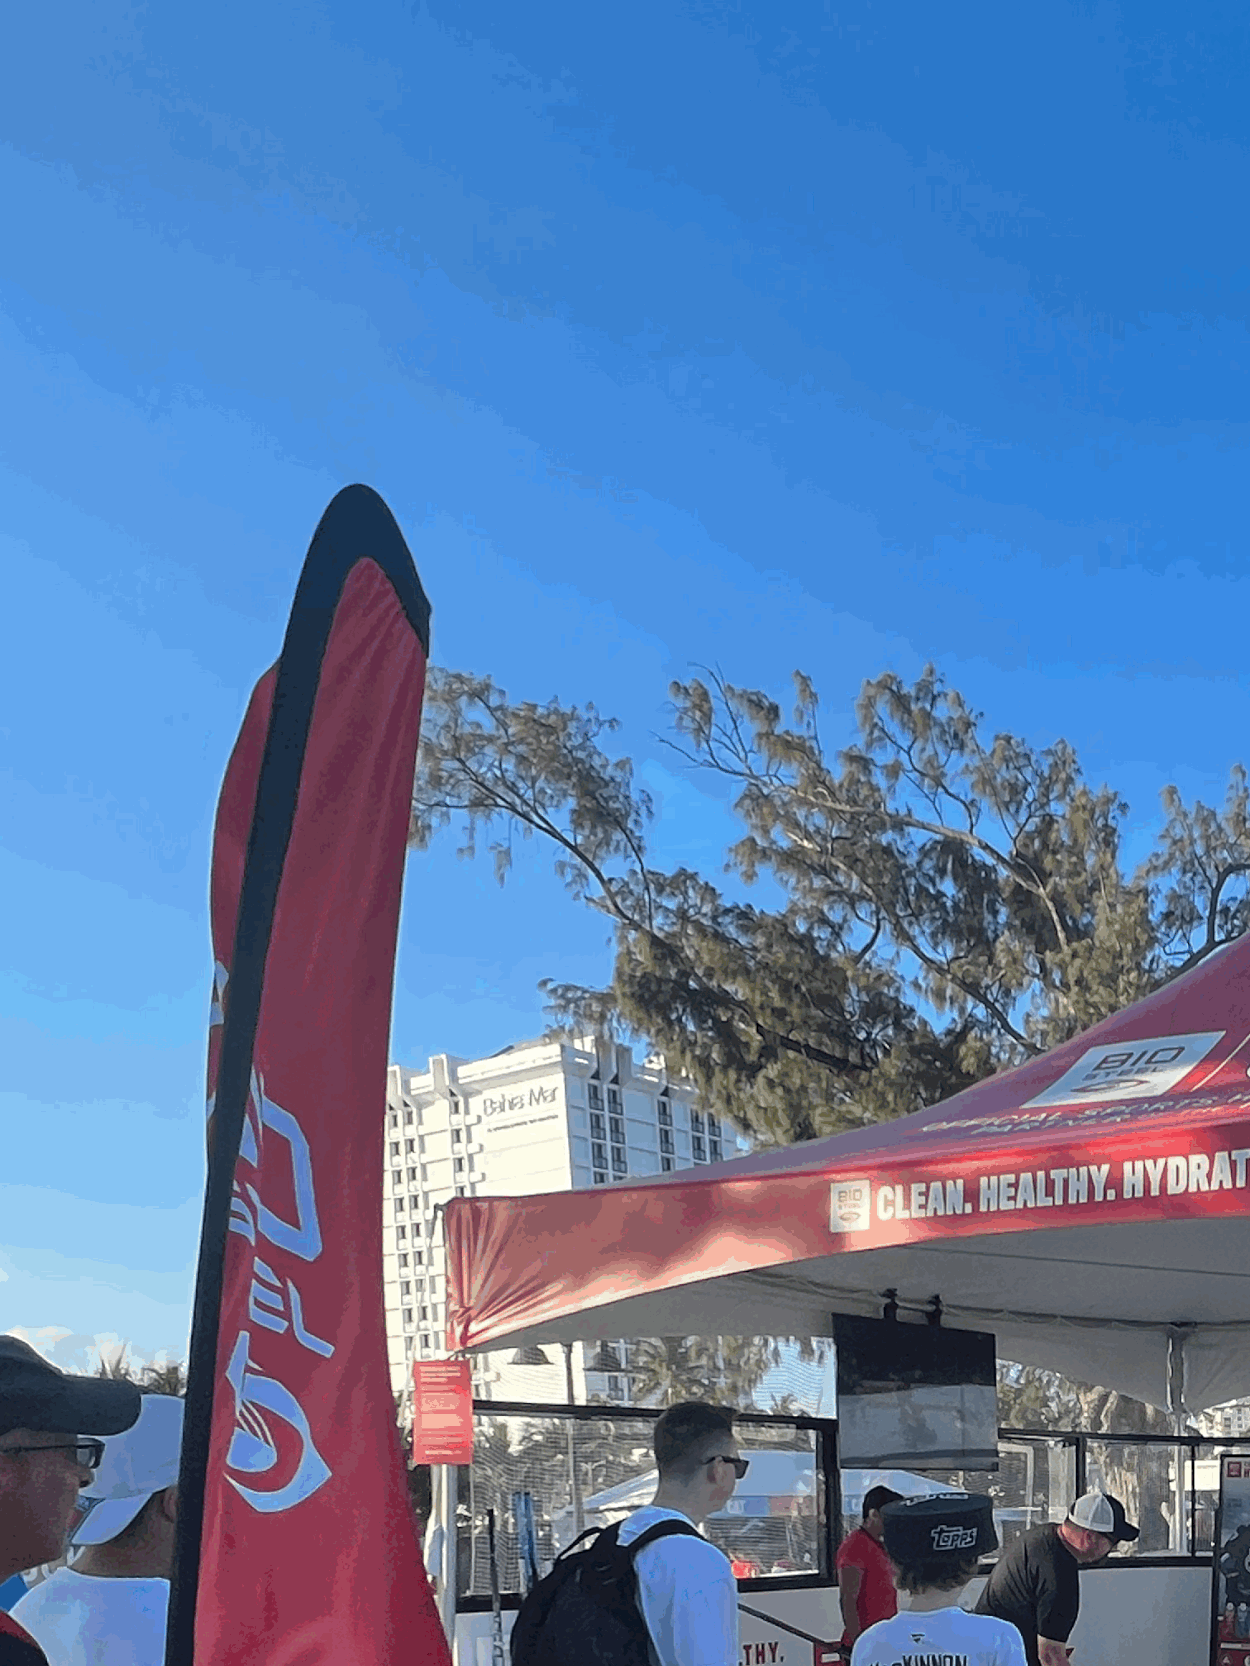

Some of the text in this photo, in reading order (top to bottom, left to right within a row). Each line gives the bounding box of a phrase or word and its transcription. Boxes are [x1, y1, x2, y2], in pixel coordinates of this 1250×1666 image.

[1092, 1046, 1186, 1072] BIO
[876, 1178, 973, 1221] CLEAN.
[979, 1164, 1116, 1212] HEALTHY.
